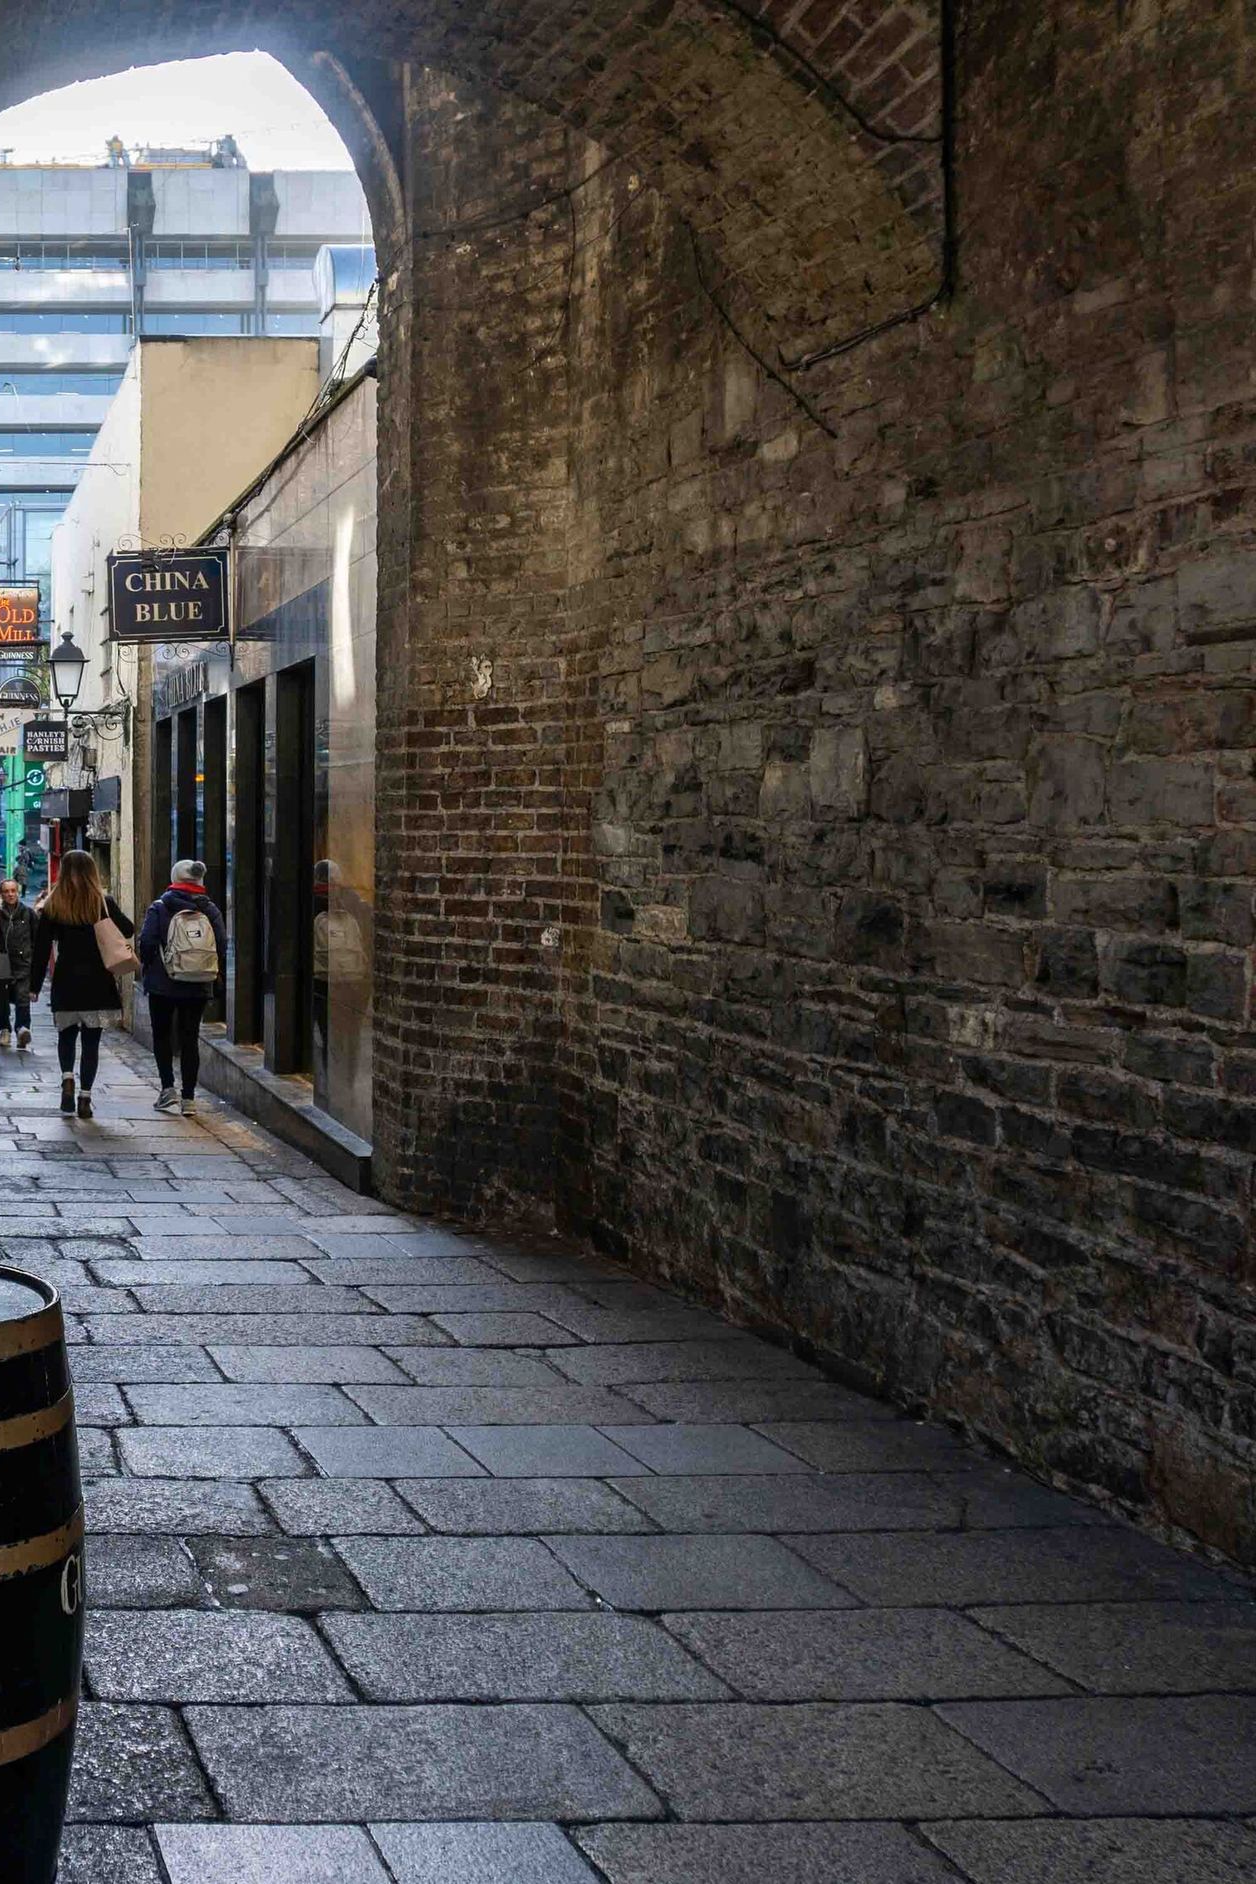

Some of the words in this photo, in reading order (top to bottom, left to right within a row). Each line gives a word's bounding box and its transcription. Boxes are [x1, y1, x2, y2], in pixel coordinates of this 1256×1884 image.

[125, 570, 210, 592] CHINA
[135, 601, 203, 622] BLUE
[27, 744, 65, 752] PASTIES
